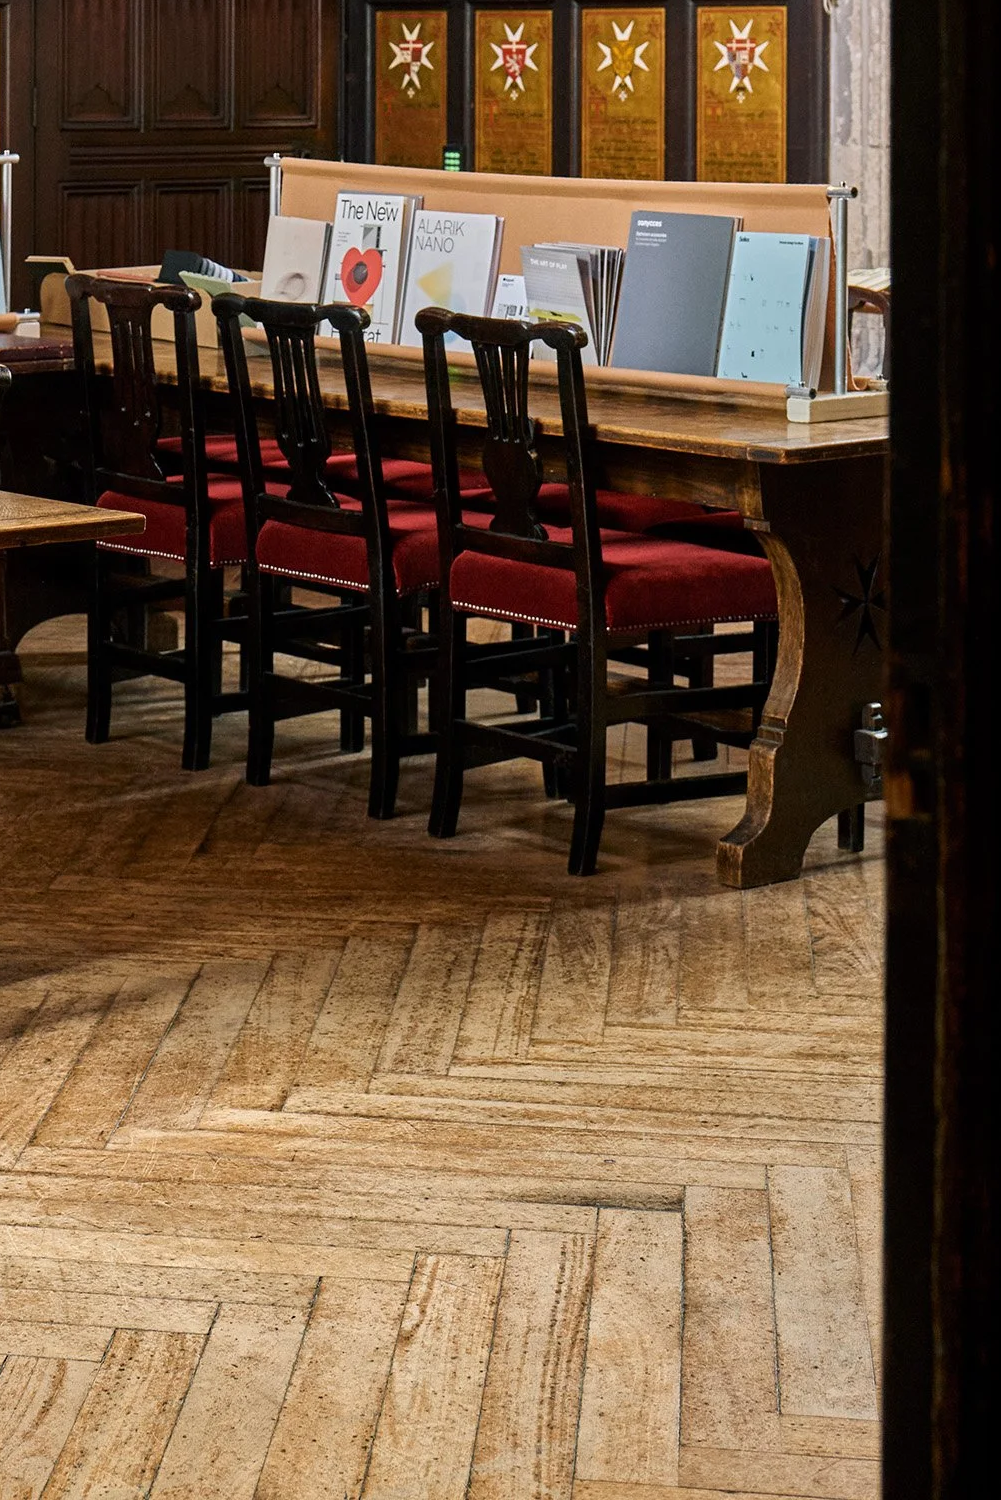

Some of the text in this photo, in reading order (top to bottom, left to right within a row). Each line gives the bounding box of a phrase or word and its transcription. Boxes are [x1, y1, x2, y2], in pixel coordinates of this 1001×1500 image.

[341, 198, 399, 222] The New
[416, 218, 465, 237] ALARIK
[414, 235, 455, 254] NANO
